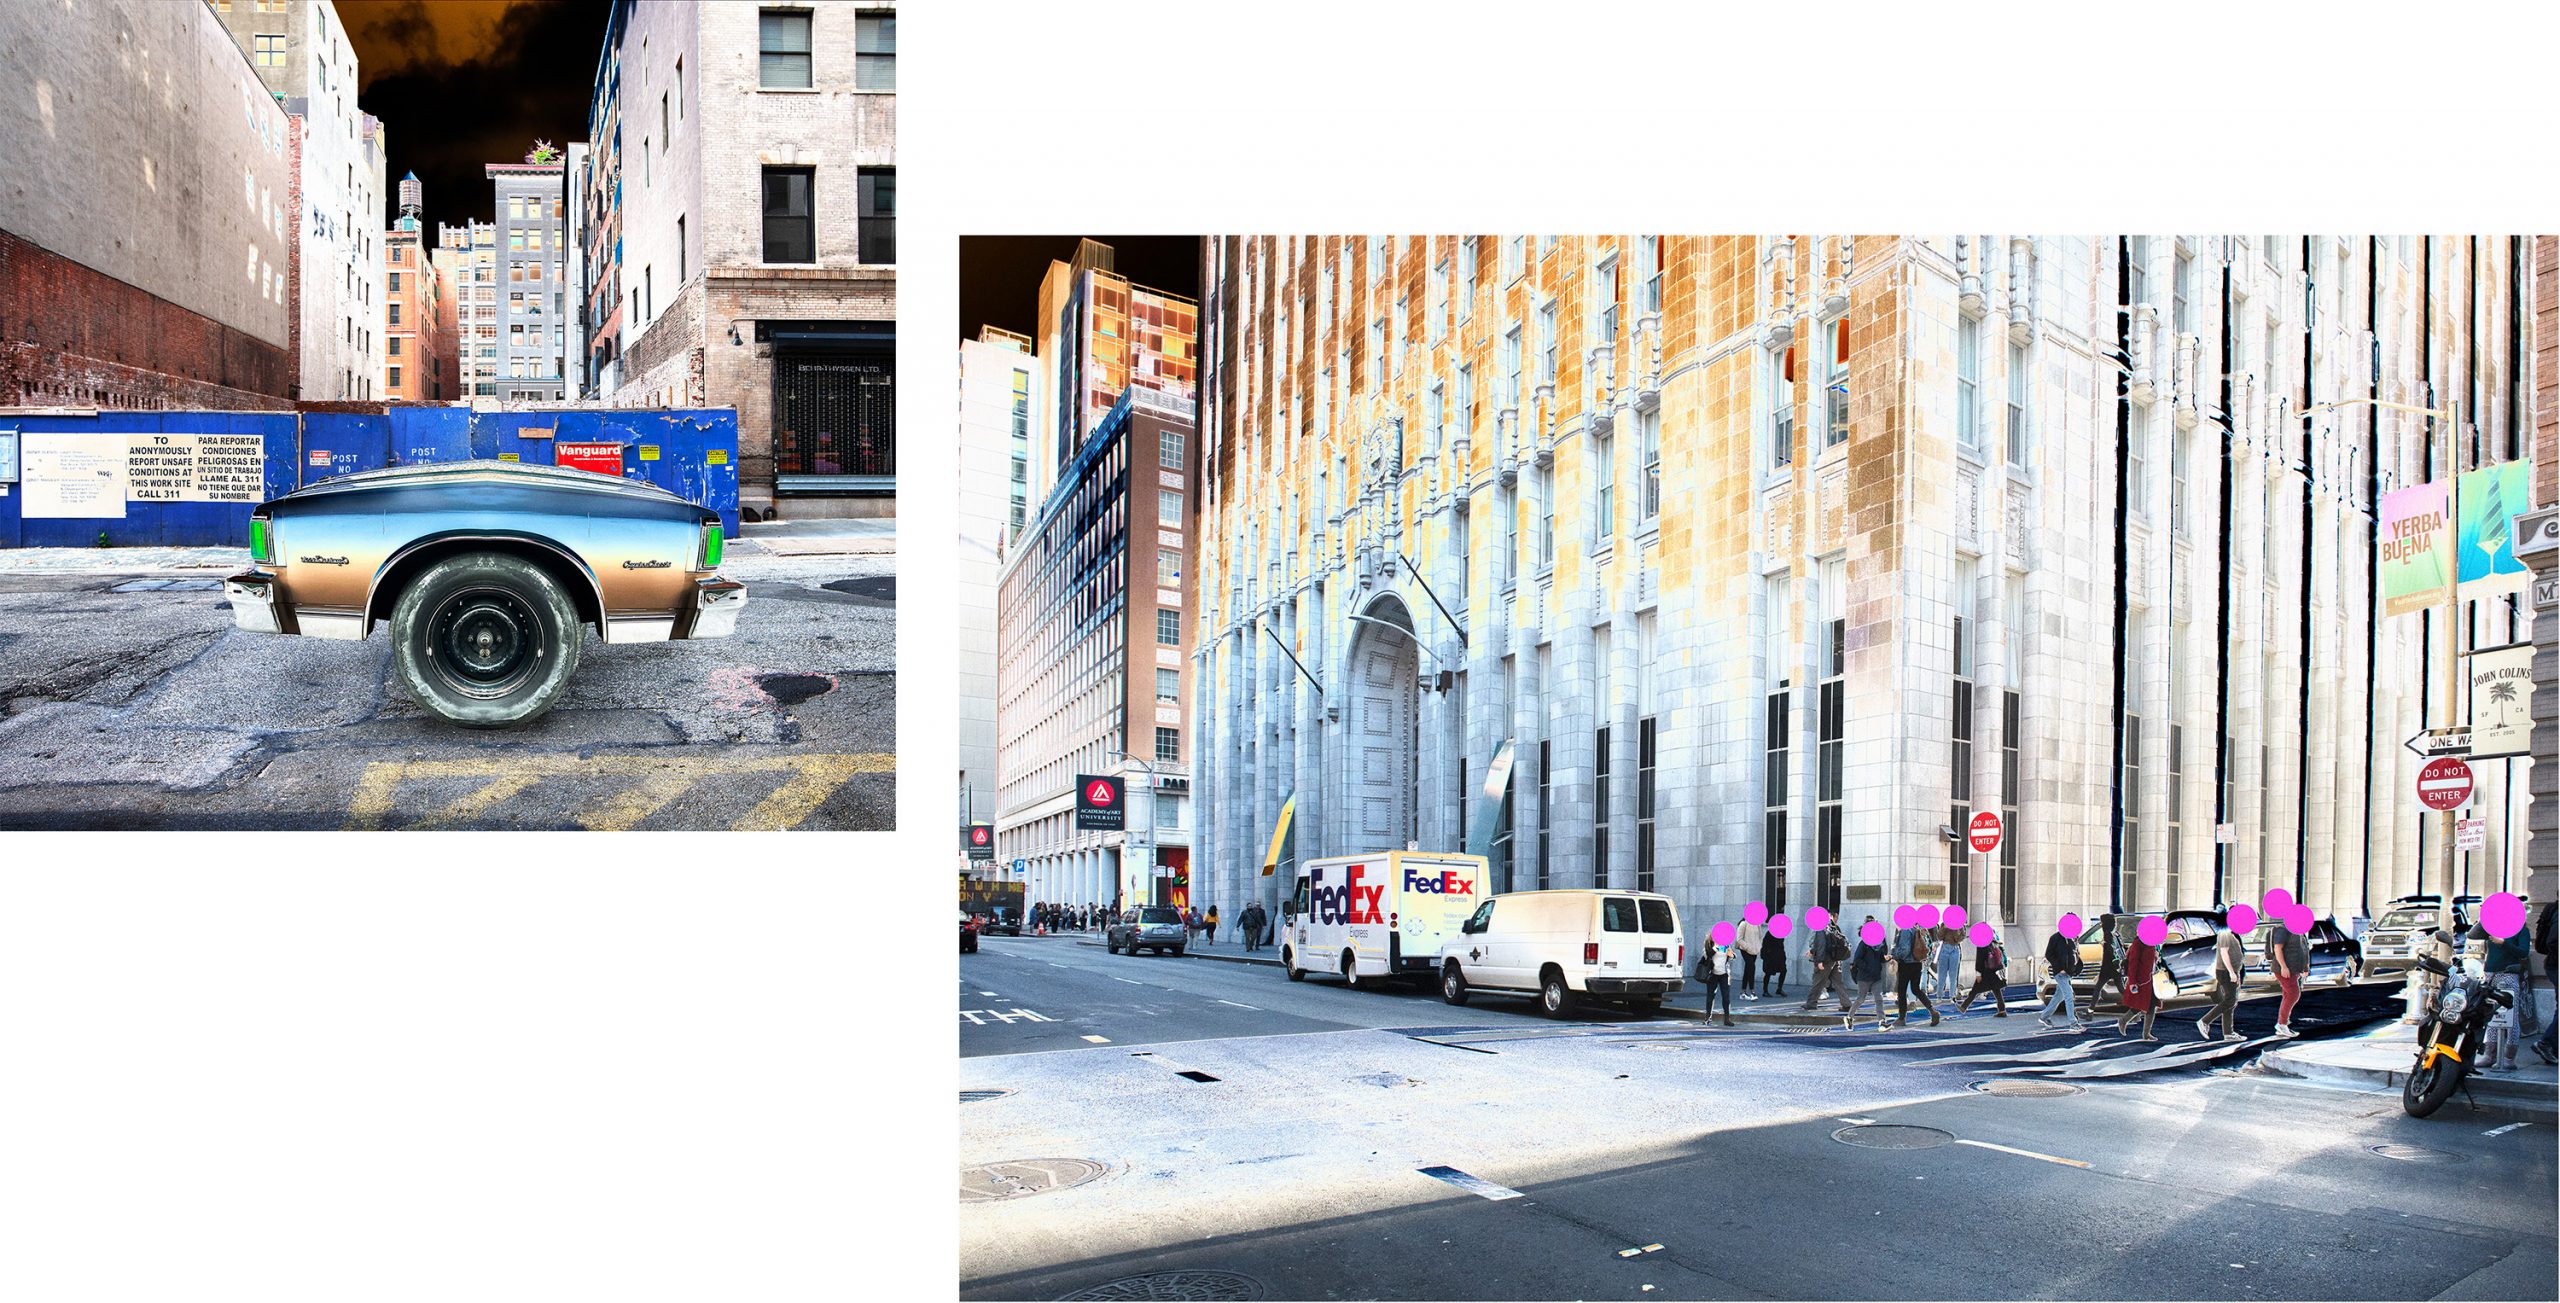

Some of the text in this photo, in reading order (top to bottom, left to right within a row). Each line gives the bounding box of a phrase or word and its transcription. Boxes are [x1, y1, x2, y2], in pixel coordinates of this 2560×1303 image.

[154, 436, 168, 445] TO
[198, 437, 261, 446] PARA REPORTAR
[129, 446, 192, 455] ANONYMOUSLY
[202, 447, 256, 455] CONDICIONES
[411, 447, 437, 456] POST
[559, 445, 621, 457] Vanguard
[129, 457, 159, 466] REPORT
[162, 457, 192, 466] UNSAFE
[198, 457, 261, 466] PELIGROSAS EN
[332, 454, 358, 463] POST
[129, 468, 192, 476] CONDITIONS AT
[338, 465, 351, 473] NO
[131, 479, 191, 488] THIS WORK SITE
[245, 475, 260, 483] 311
[137, 490, 180, 498] CALL 311
[221, 492, 250, 500] NOMBRE
[2391, 510, 2442, 540] YERBA
[2383, 533, 2432, 566] BUENA
[2473, 667, 2532, 687] JOHN COLINS
[2430, 735, 2472, 748] ONE WA
[2425, 767, 2465, 778] DO NOT
[2428, 790, 2461, 801] ENTER
[1984, 819, 1997, 827] NOT
[1404, 869, 1474, 895] FedEx
[1310, 864, 1384, 926] FedEx
[1444, 895, 1468, 903] Express
[1350, 926, 1369, 940] Express
